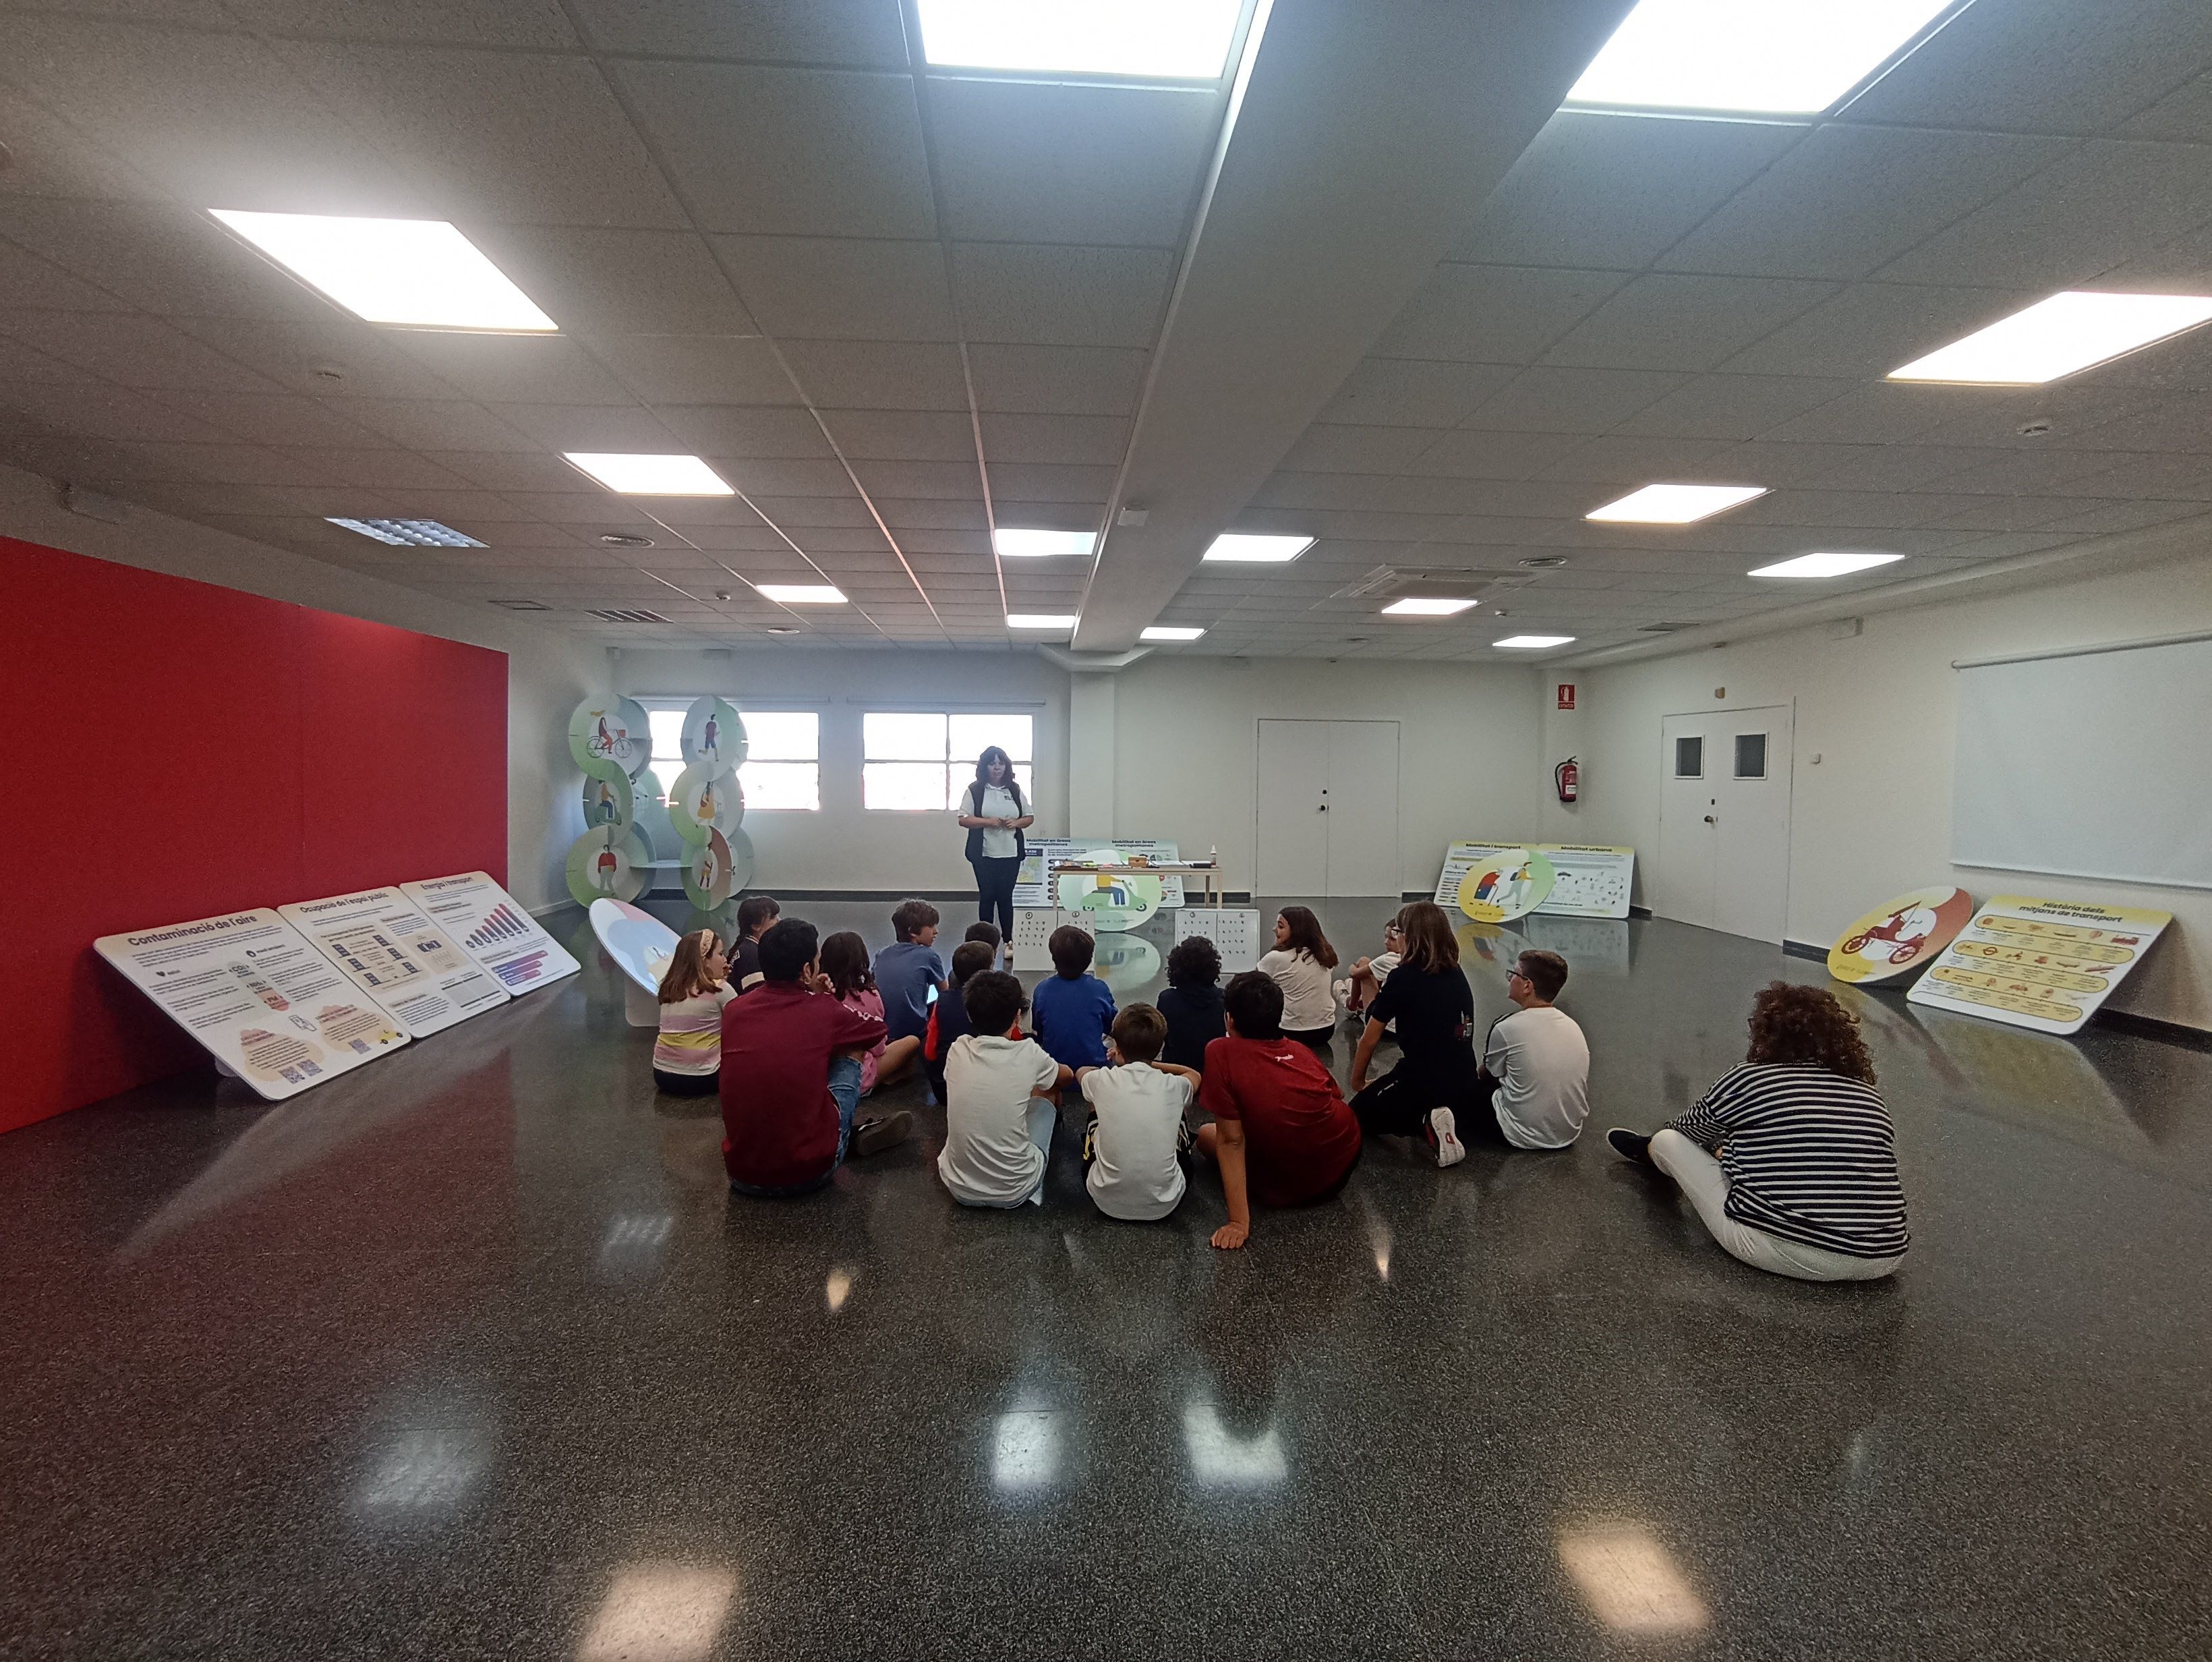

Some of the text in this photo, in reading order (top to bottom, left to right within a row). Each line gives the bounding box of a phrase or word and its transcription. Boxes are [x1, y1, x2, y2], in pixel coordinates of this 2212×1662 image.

[299, 901, 337, 913] Ocupació
[2042, 902, 2081, 911] Història
[2018, 906, 2056, 914] mitjans
[2071, 912, 2122, 922] transport
[127, 915, 258, 946] Contaminació de l'aire
